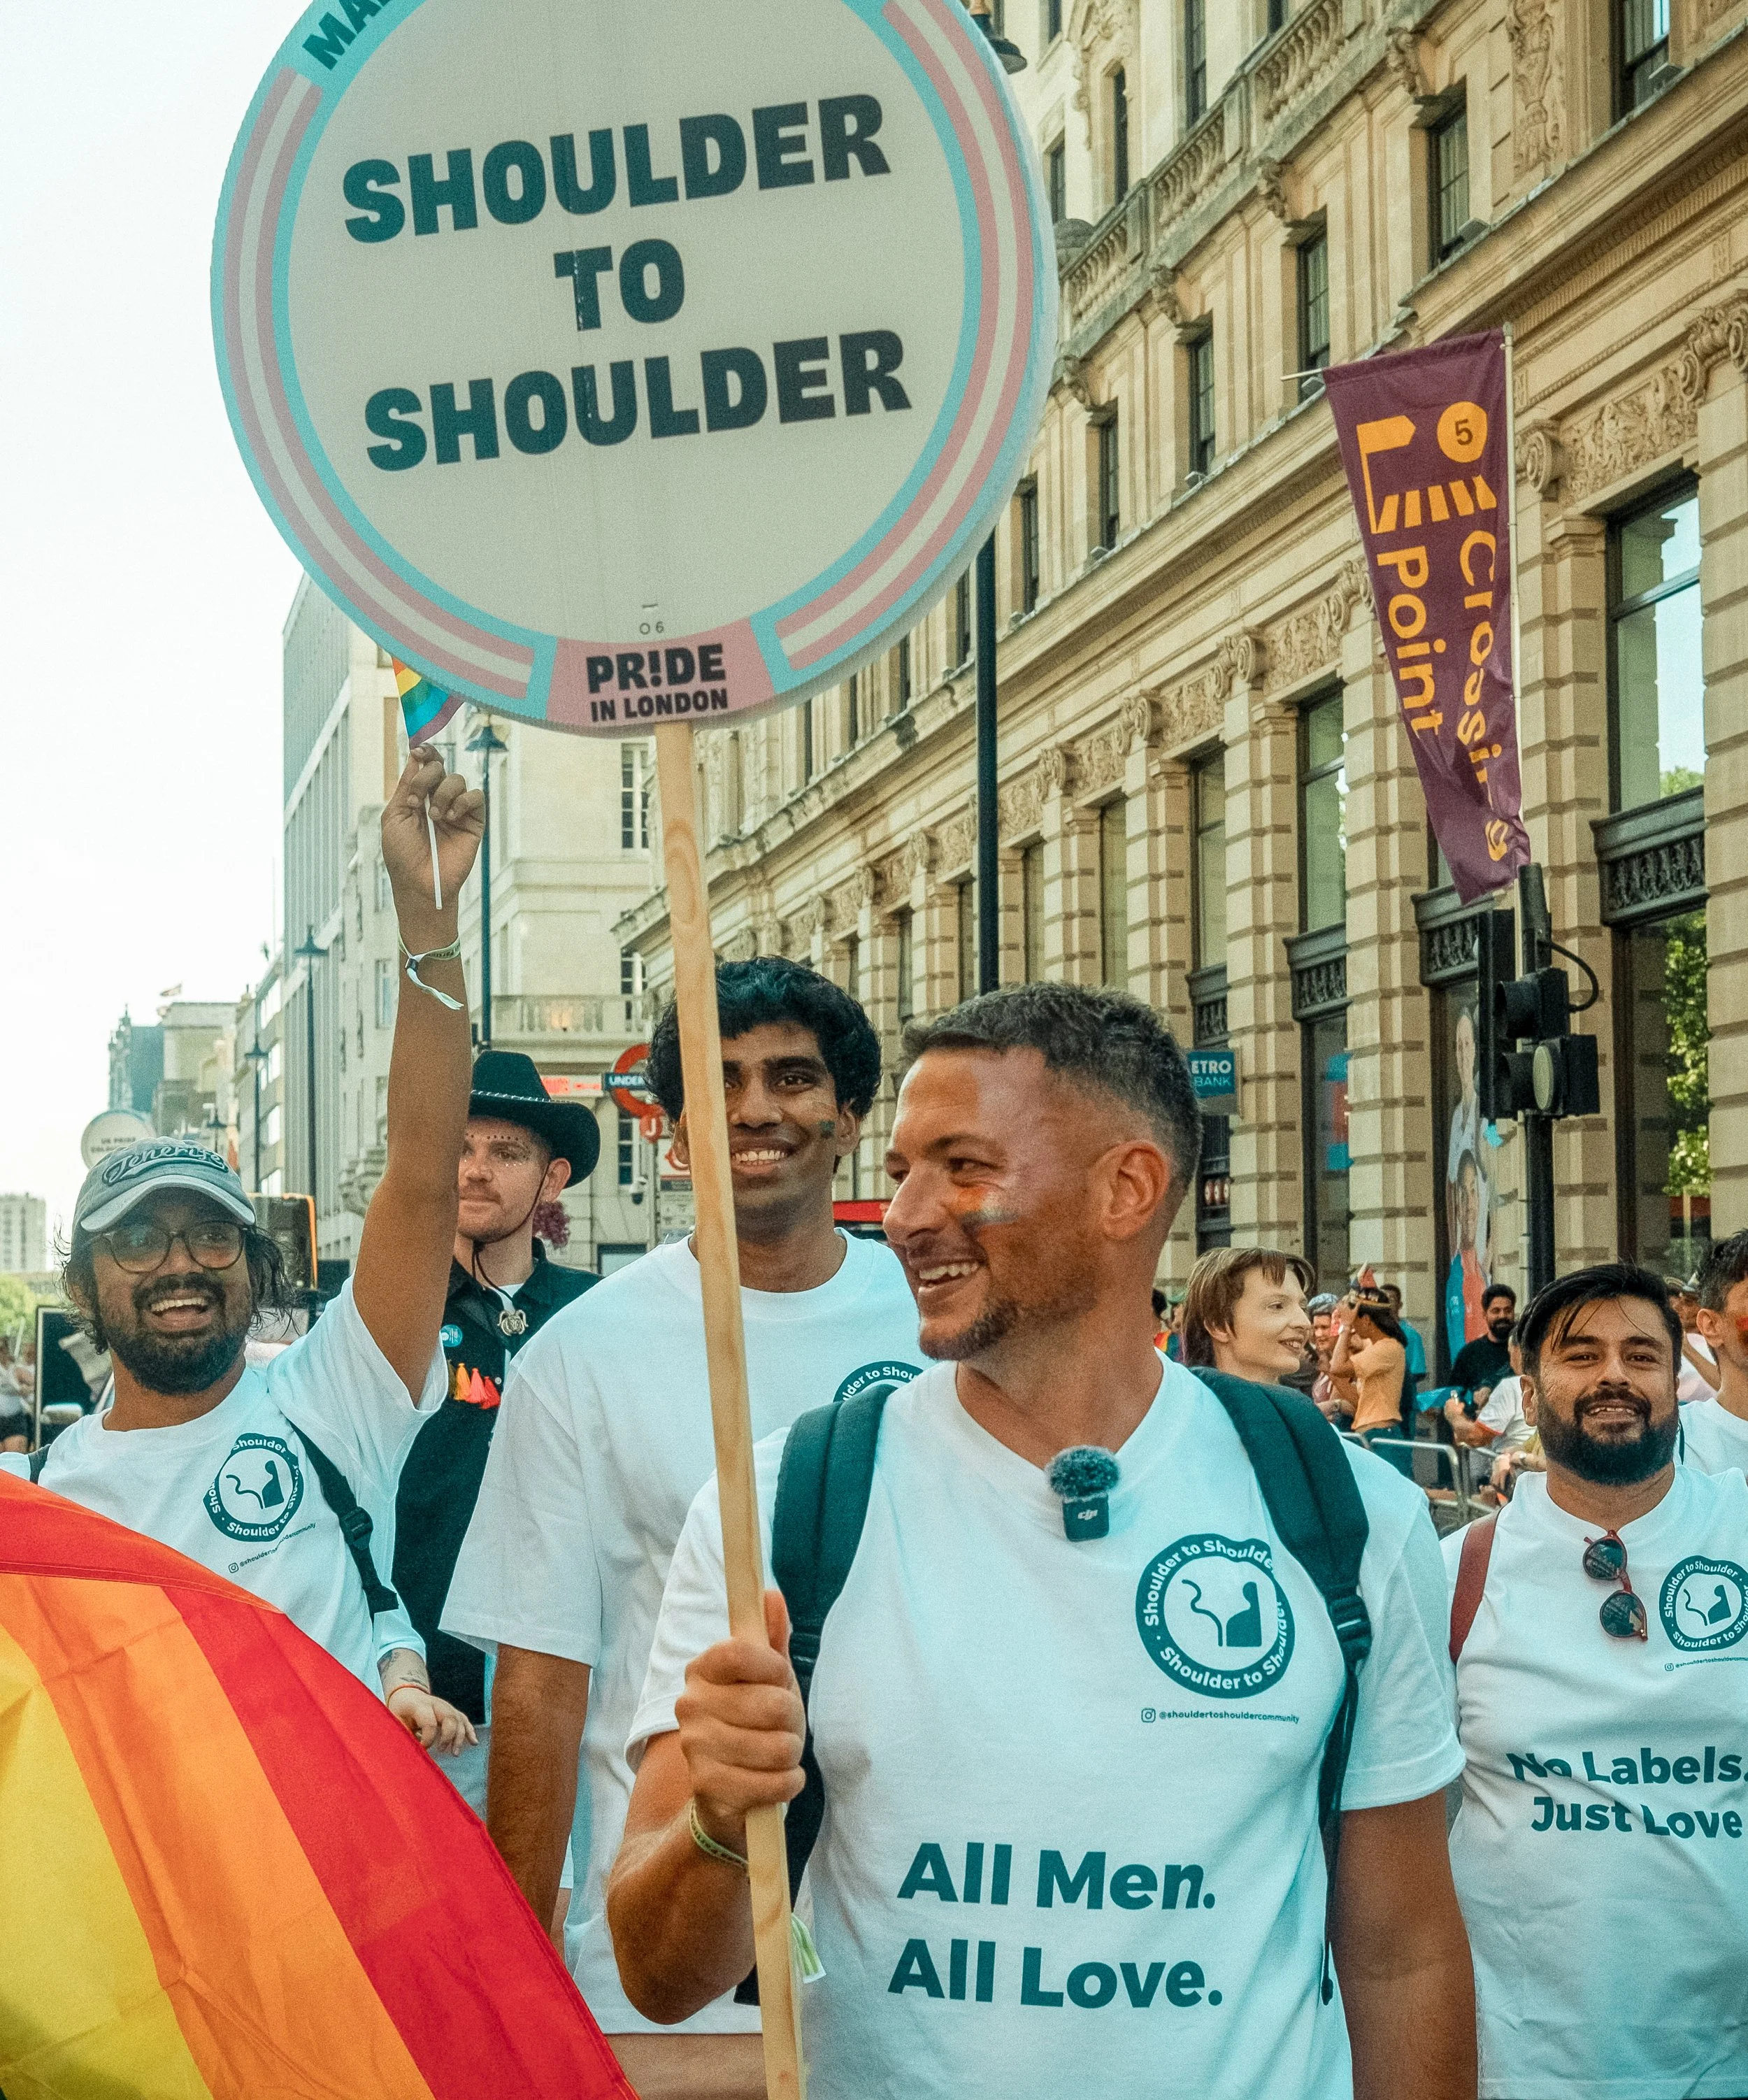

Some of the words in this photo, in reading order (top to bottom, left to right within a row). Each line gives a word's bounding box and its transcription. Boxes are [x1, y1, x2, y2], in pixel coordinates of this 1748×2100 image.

[302, 0, 392, 71] MA
[343, 94, 890, 244] SHOULDER
[554, 238, 685, 331] TO
[365, 330, 911, 472] SHOULDER
[1454, 418, 1473, 446] 5
[1376, 545, 1445, 735] Point
[587, 643, 726, 694] PR!DE
[591, 700, 616, 722] IN
[625, 689, 728, 719] LONDON
[1456, 530, 1510, 862] Crossig
[1191, 1059, 1231, 1074] ETRO
[1194, 1076, 1231, 1087] BANK
[101, 1145, 229, 1186] Tenerife
[842, 1376, 865, 1402] lder
[866, 1370, 881, 1380] to
[233, 1438, 287, 1453] Shoulder
[227, 1522, 280, 1536] Shoulder
[280, 1511, 289, 1524] to
[1142, 1552, 1182, 1627] Shoulder
[1181, 1543, 1201, 1556] to
[1203, 1540, 1274, 1573] Shoulde
[1664, 1568, 1686, 1618] Shoulder
[1686, 1564, 1693, 1573] to
[1695, 1561, 1738, 1578] Shoulder
[1672, 1631, 1721, 1648] Shoulder
[1723, 1631, 1735, 1642] to
[1160, 1646, 1242, 1690] Shoulder
[1244, 1672, 1263, 1687] to
[1159, 1710, 1300, 1724] @shouldertoshouldercommunity
[1506, 1752, 1573, 1781] No
[1531, 1796, 1633, 1832] Just
[1641, 1804, 1743, 1839] Love
[897, 1842, 1012, 1906] All
[1036, 1849, 1217, 1910] Men.
[887, 1938, 996, 2003] All
[1020, 1946, 1224, 2008] Love.
